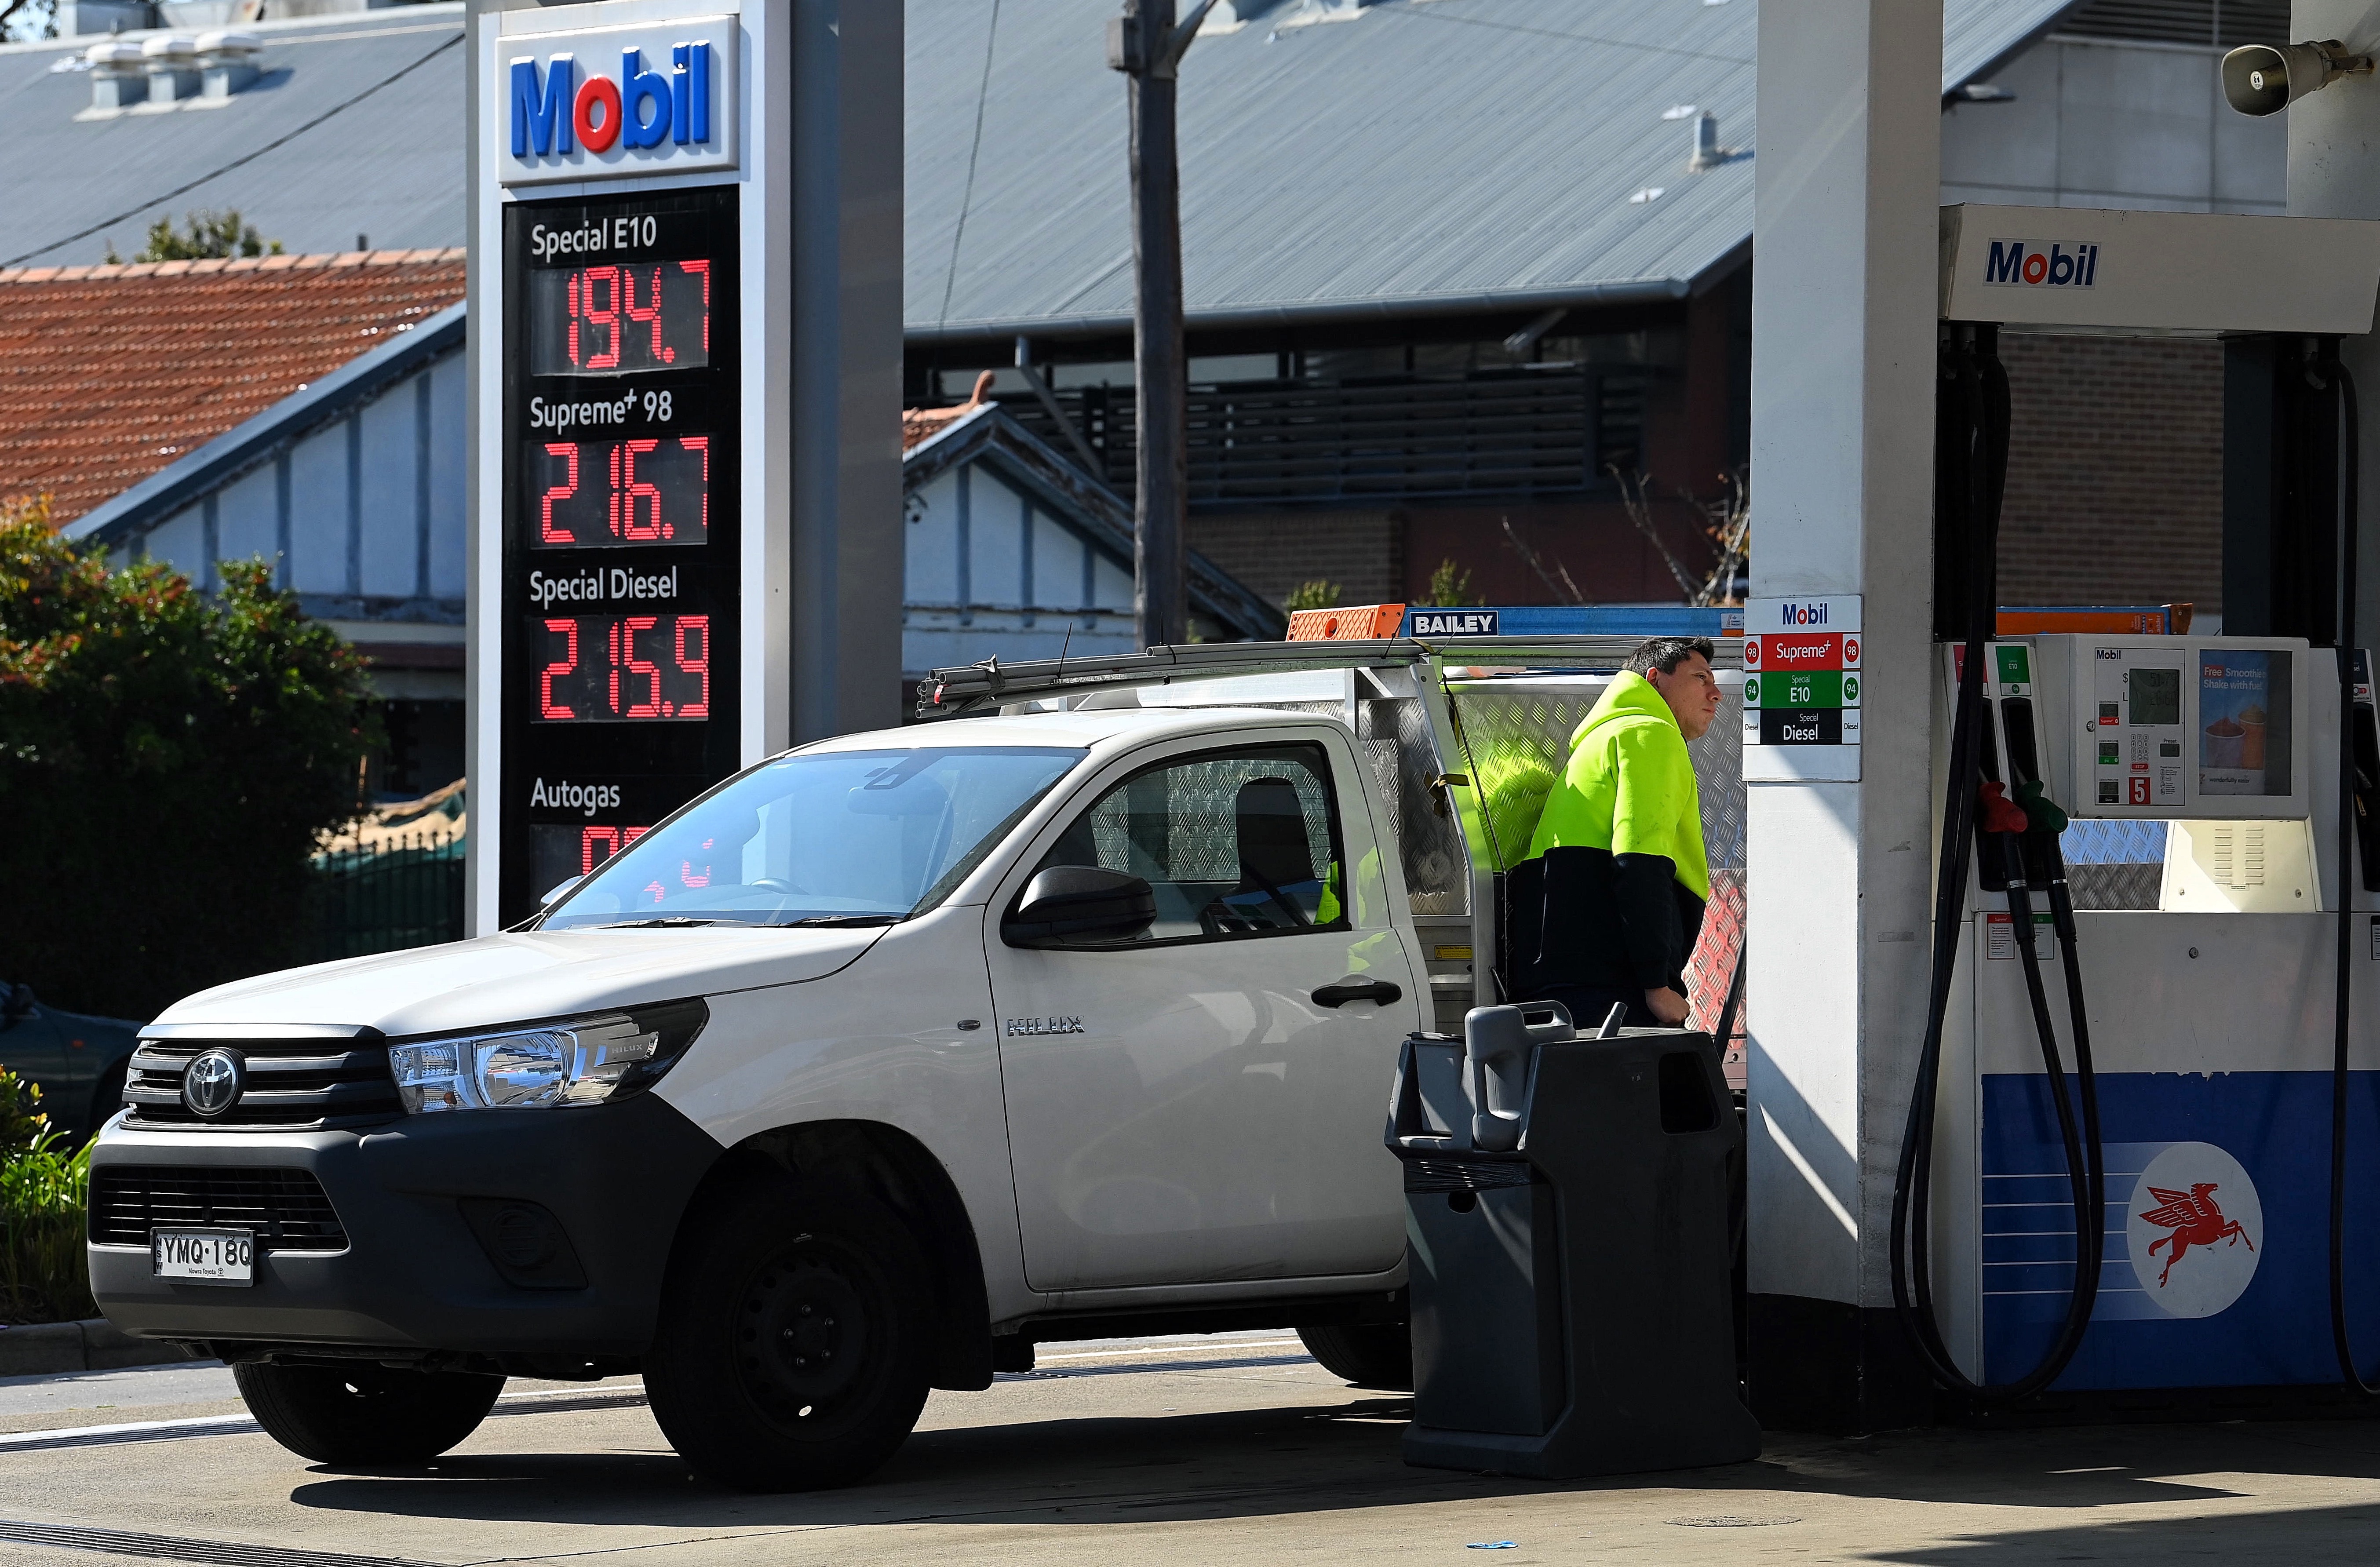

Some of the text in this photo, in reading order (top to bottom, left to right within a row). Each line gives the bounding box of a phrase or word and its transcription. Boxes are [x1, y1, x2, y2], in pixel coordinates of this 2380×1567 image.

[510, 40, 711, 158] Mobil
[532, 216, 656, 263] Special E10
[1986, 241, 2098, 286] Mobil
[568, 259, 711, 368] 194.7
[530, 389, 672, 435] Supreme+ 98
[542, 436, 709, 544] 216.7
[530, 566, 678, 609] Special Diesel
[1782, 603, 1828, 625] Mobil
[1415, 615, 1493, 633] BAILEY
[1748, 648, 1757, 658] 98
[1776, 640, 1831, 663] Supreme+
[1847, 646, 1857, 656] 98
[2096, 650, 2121, 660] Mobil
[541, 614, 709, 719] 215.9
[2204, 667, 2222, 676] Free
[1791, 675, 1810, 685] Special
[2123, 673, 2128, 684] $
[2204, 679, 2228, 689] Shake
[2230, 680, 2248, 690] with
[1747, 685, 1757, 696] 94
[1790, 687, 1810, 702] E10
[1846, 684, 1856, 694] 94
[2123, 692, 2128, 702] L
[1799, 713, 1819, 723] Special
[1783, 724, 1819, 740] Diesel
[530, 777, 621, 817] Autogas
[2134, 779, 2145, 802] 5
[1007, 1016, 1085, 1036] HILUX
[612, 1044, 643, 1053] HILUX
